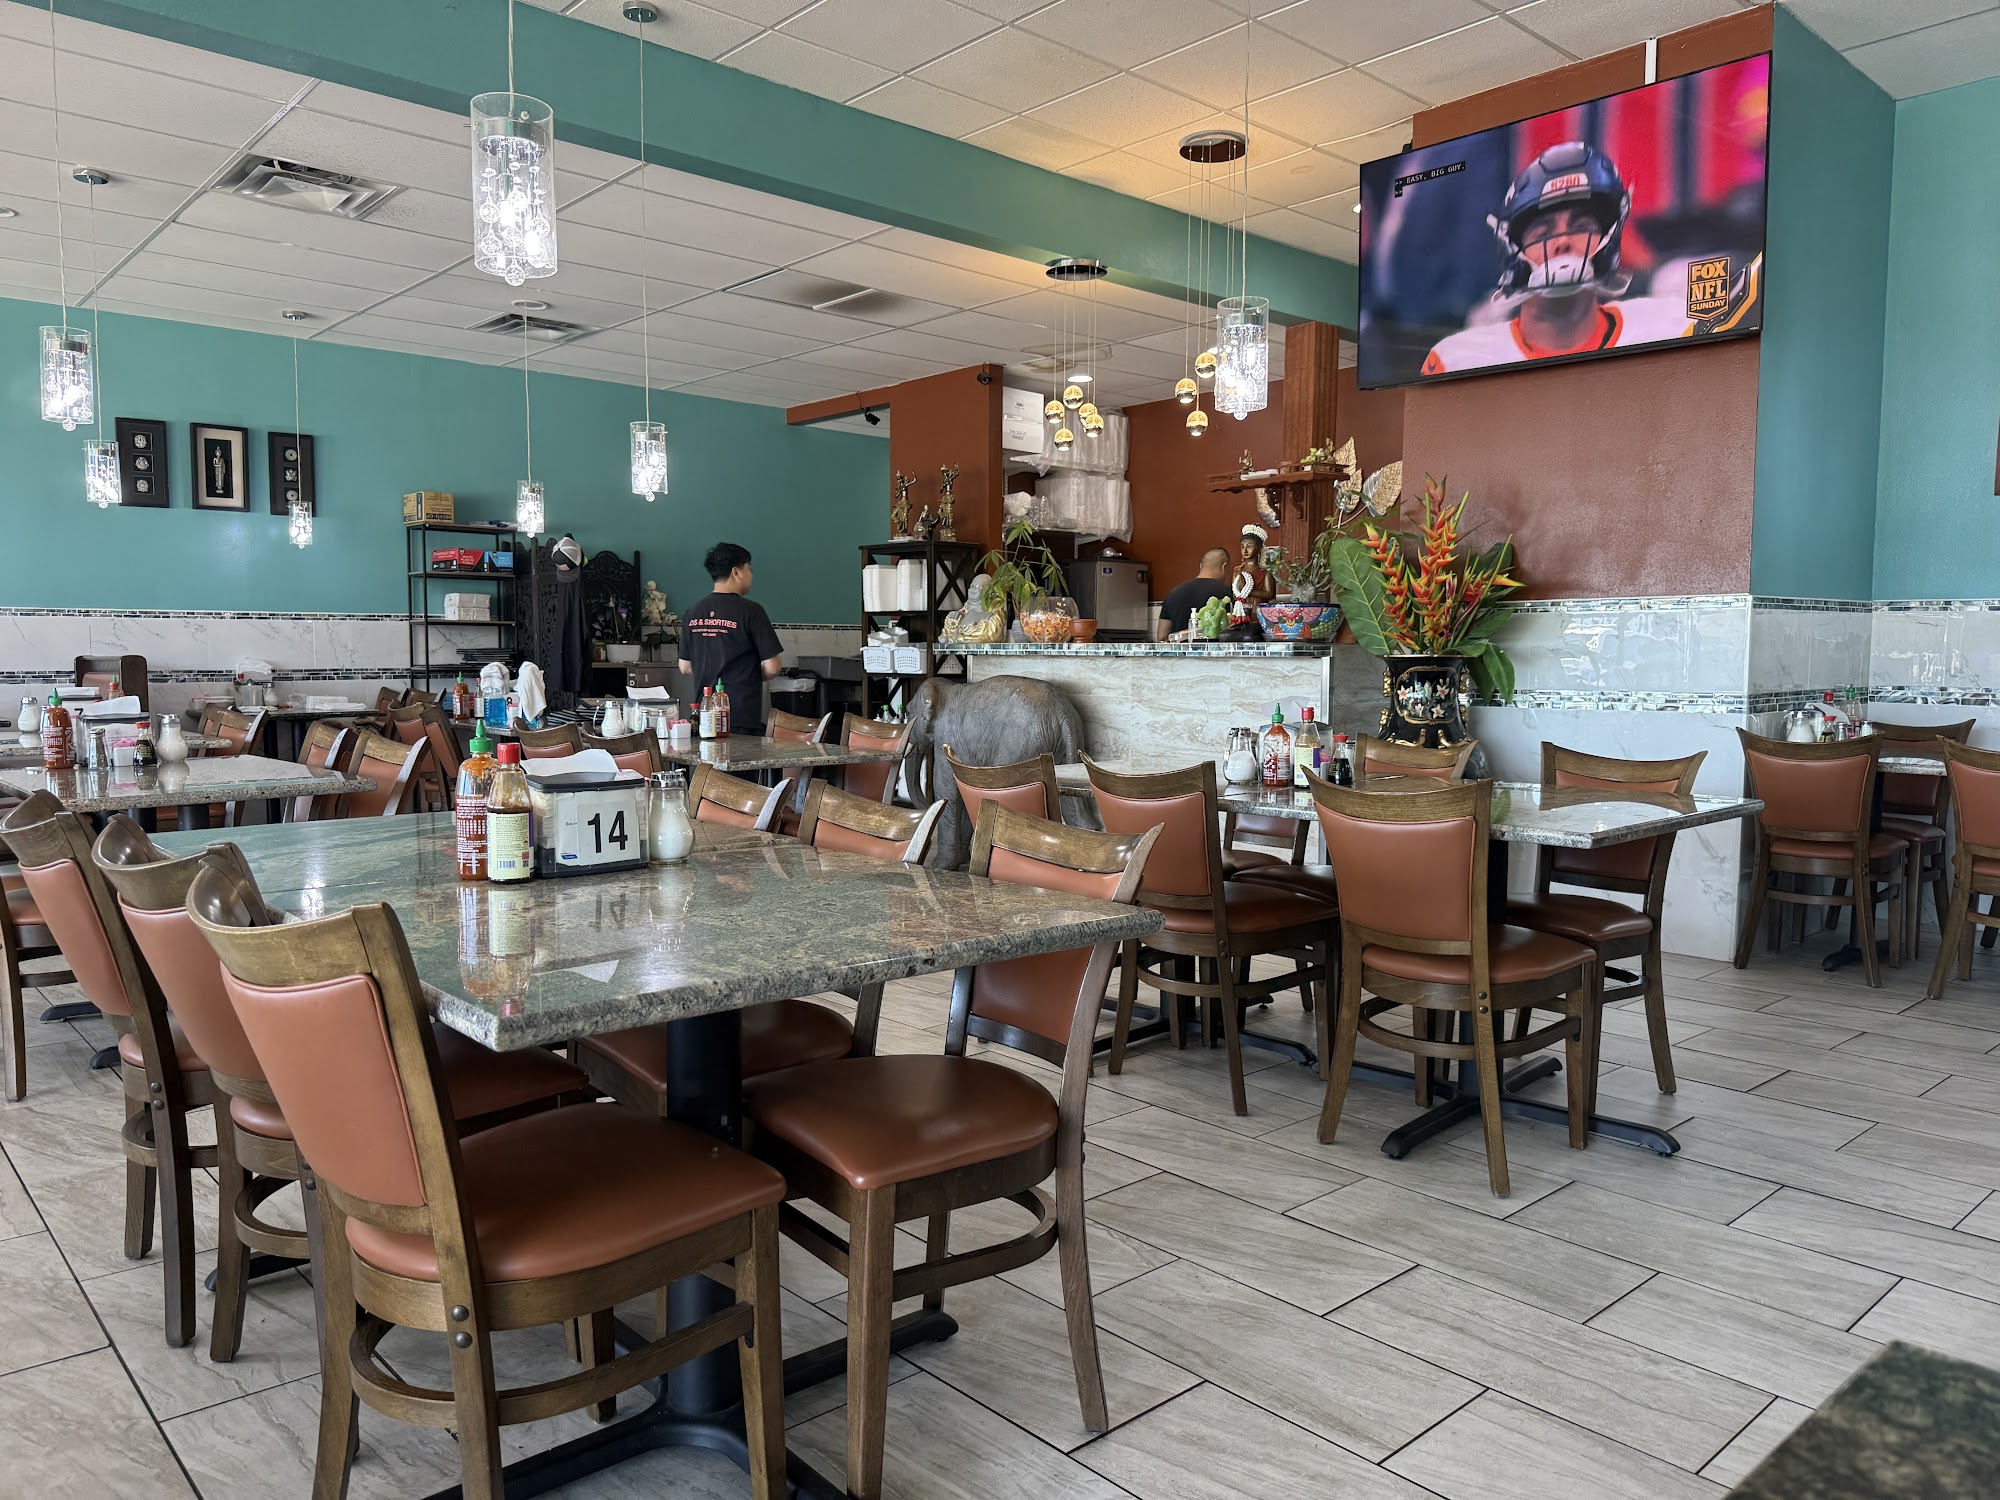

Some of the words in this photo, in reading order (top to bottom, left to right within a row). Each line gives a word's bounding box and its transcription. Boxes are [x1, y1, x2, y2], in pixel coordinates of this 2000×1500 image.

[1406, 174, 1427, 184] EASY,
[1431, 169, 1444, 178] BIG
[1447, 163, 1465, 173] GUY.
[1691, 260, 1727, 282] FOX
[1691, 280, 1727, 302] NFL
[1690, 299, 1726, 311] SUNDAY
[698, 618, 704, 626] &
[704, 619, 738, 629] SHORTIES
[587, 810, 629, 854] 14
